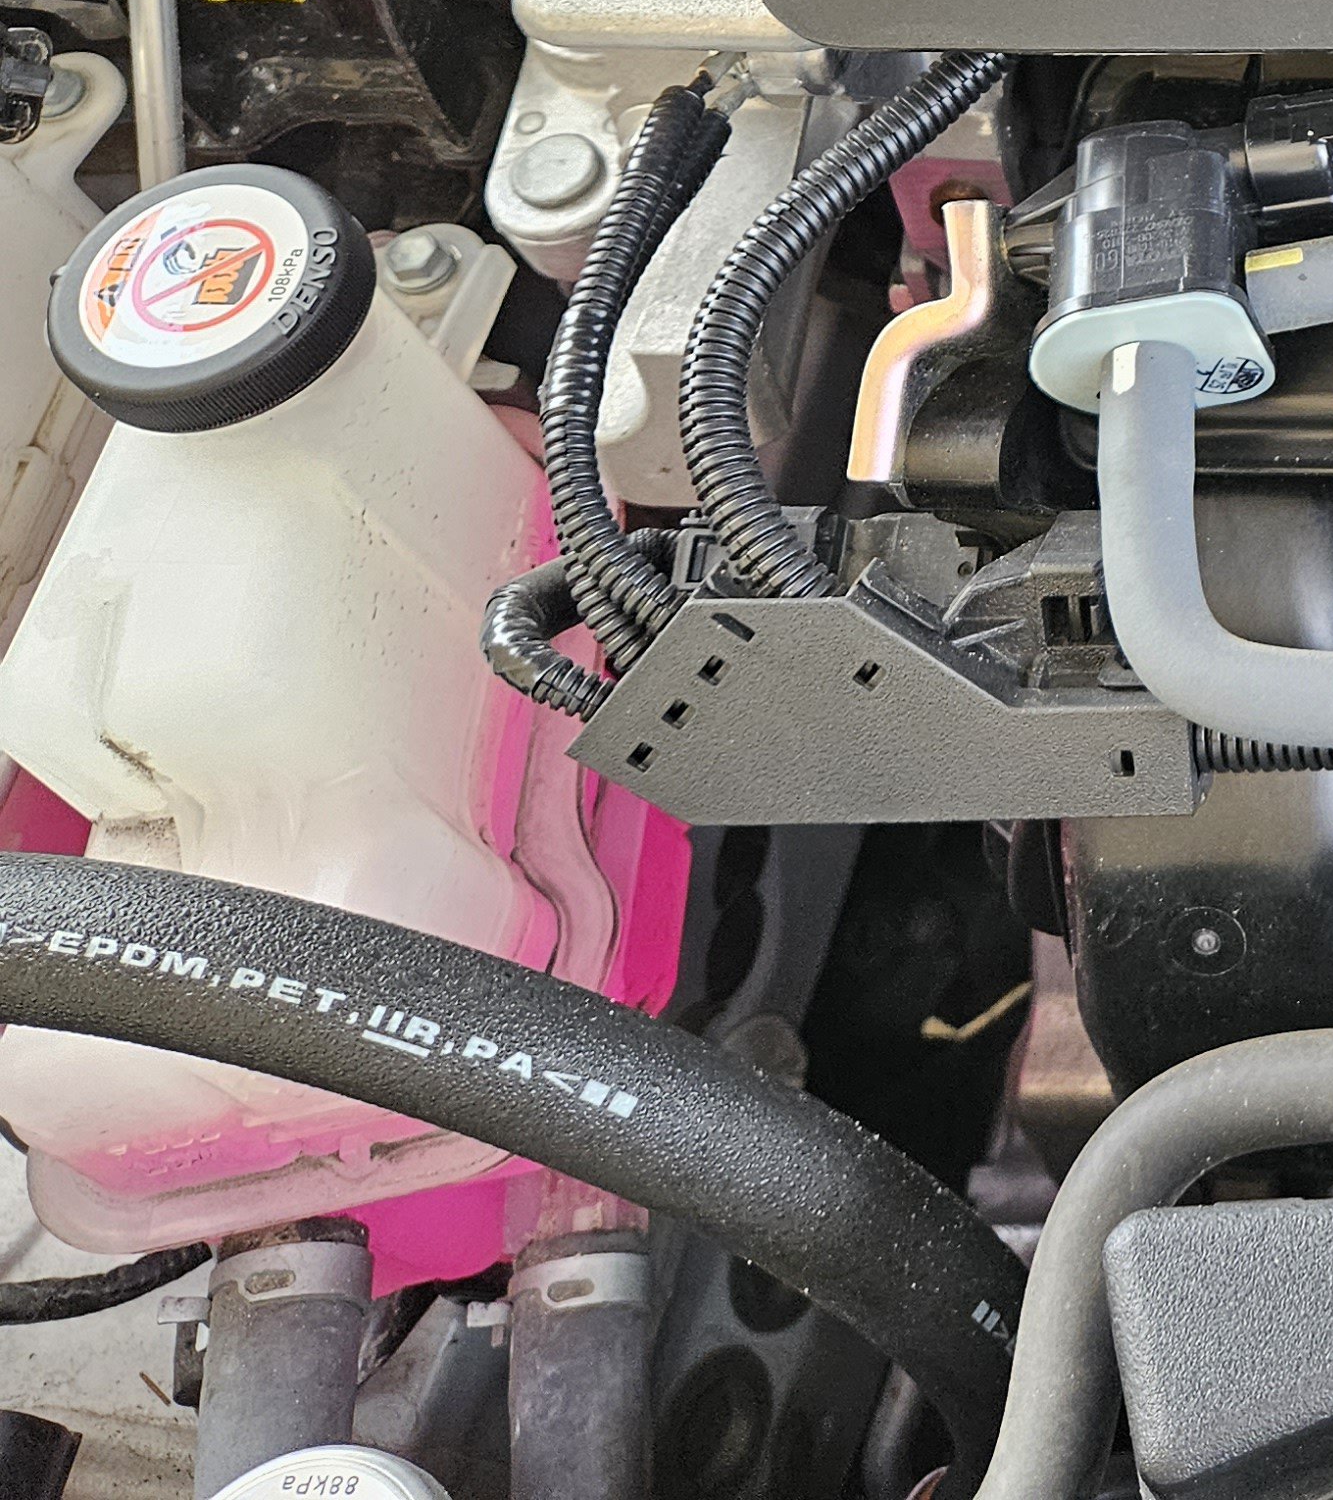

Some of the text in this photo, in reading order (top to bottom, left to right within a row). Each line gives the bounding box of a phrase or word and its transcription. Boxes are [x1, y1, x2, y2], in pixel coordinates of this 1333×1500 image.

[268, 248, 304, 302] 108kPa
[275, 227, 340, 338] DENSO
[283, 1475, 359, 1496] 88kPa
